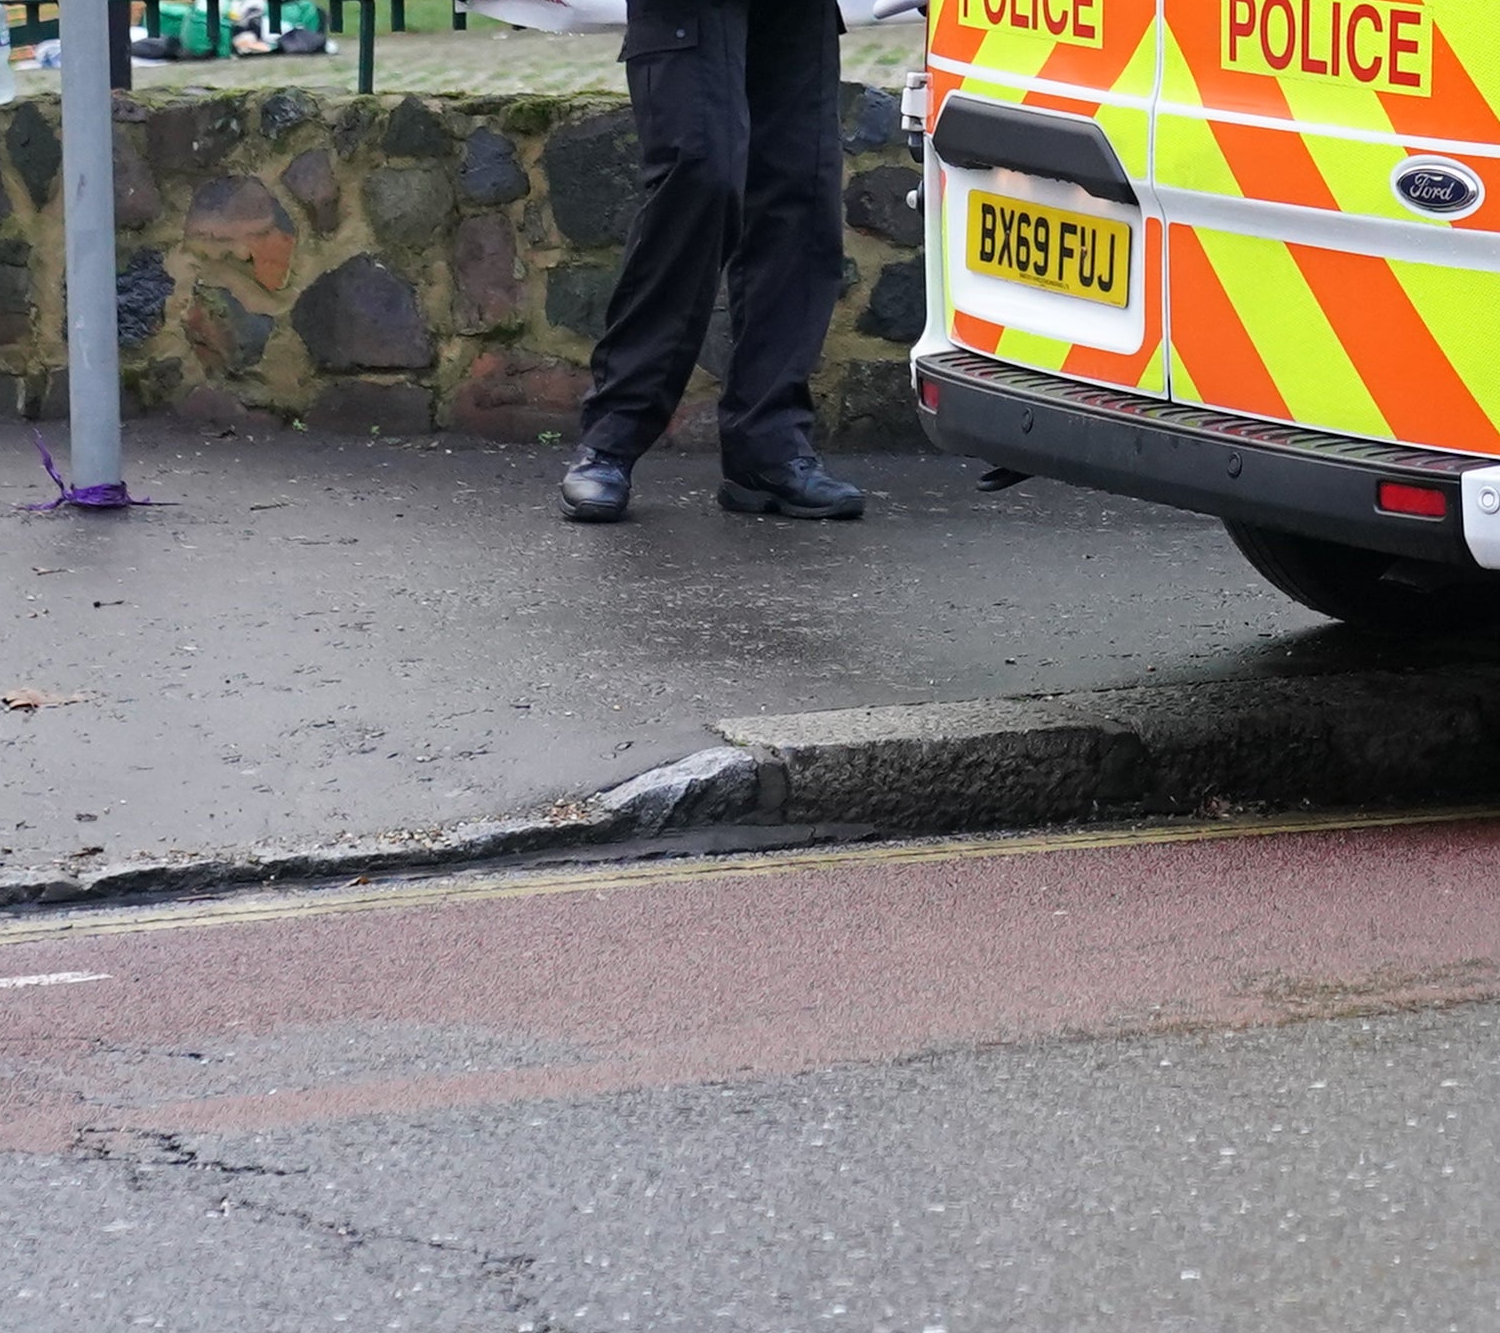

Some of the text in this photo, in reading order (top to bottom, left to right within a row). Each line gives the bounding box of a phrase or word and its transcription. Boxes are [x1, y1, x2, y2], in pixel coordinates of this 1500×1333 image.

[1408, 173, 1457, 201] Ford
[980, 203, 1115, 292] BX69 FUJ
